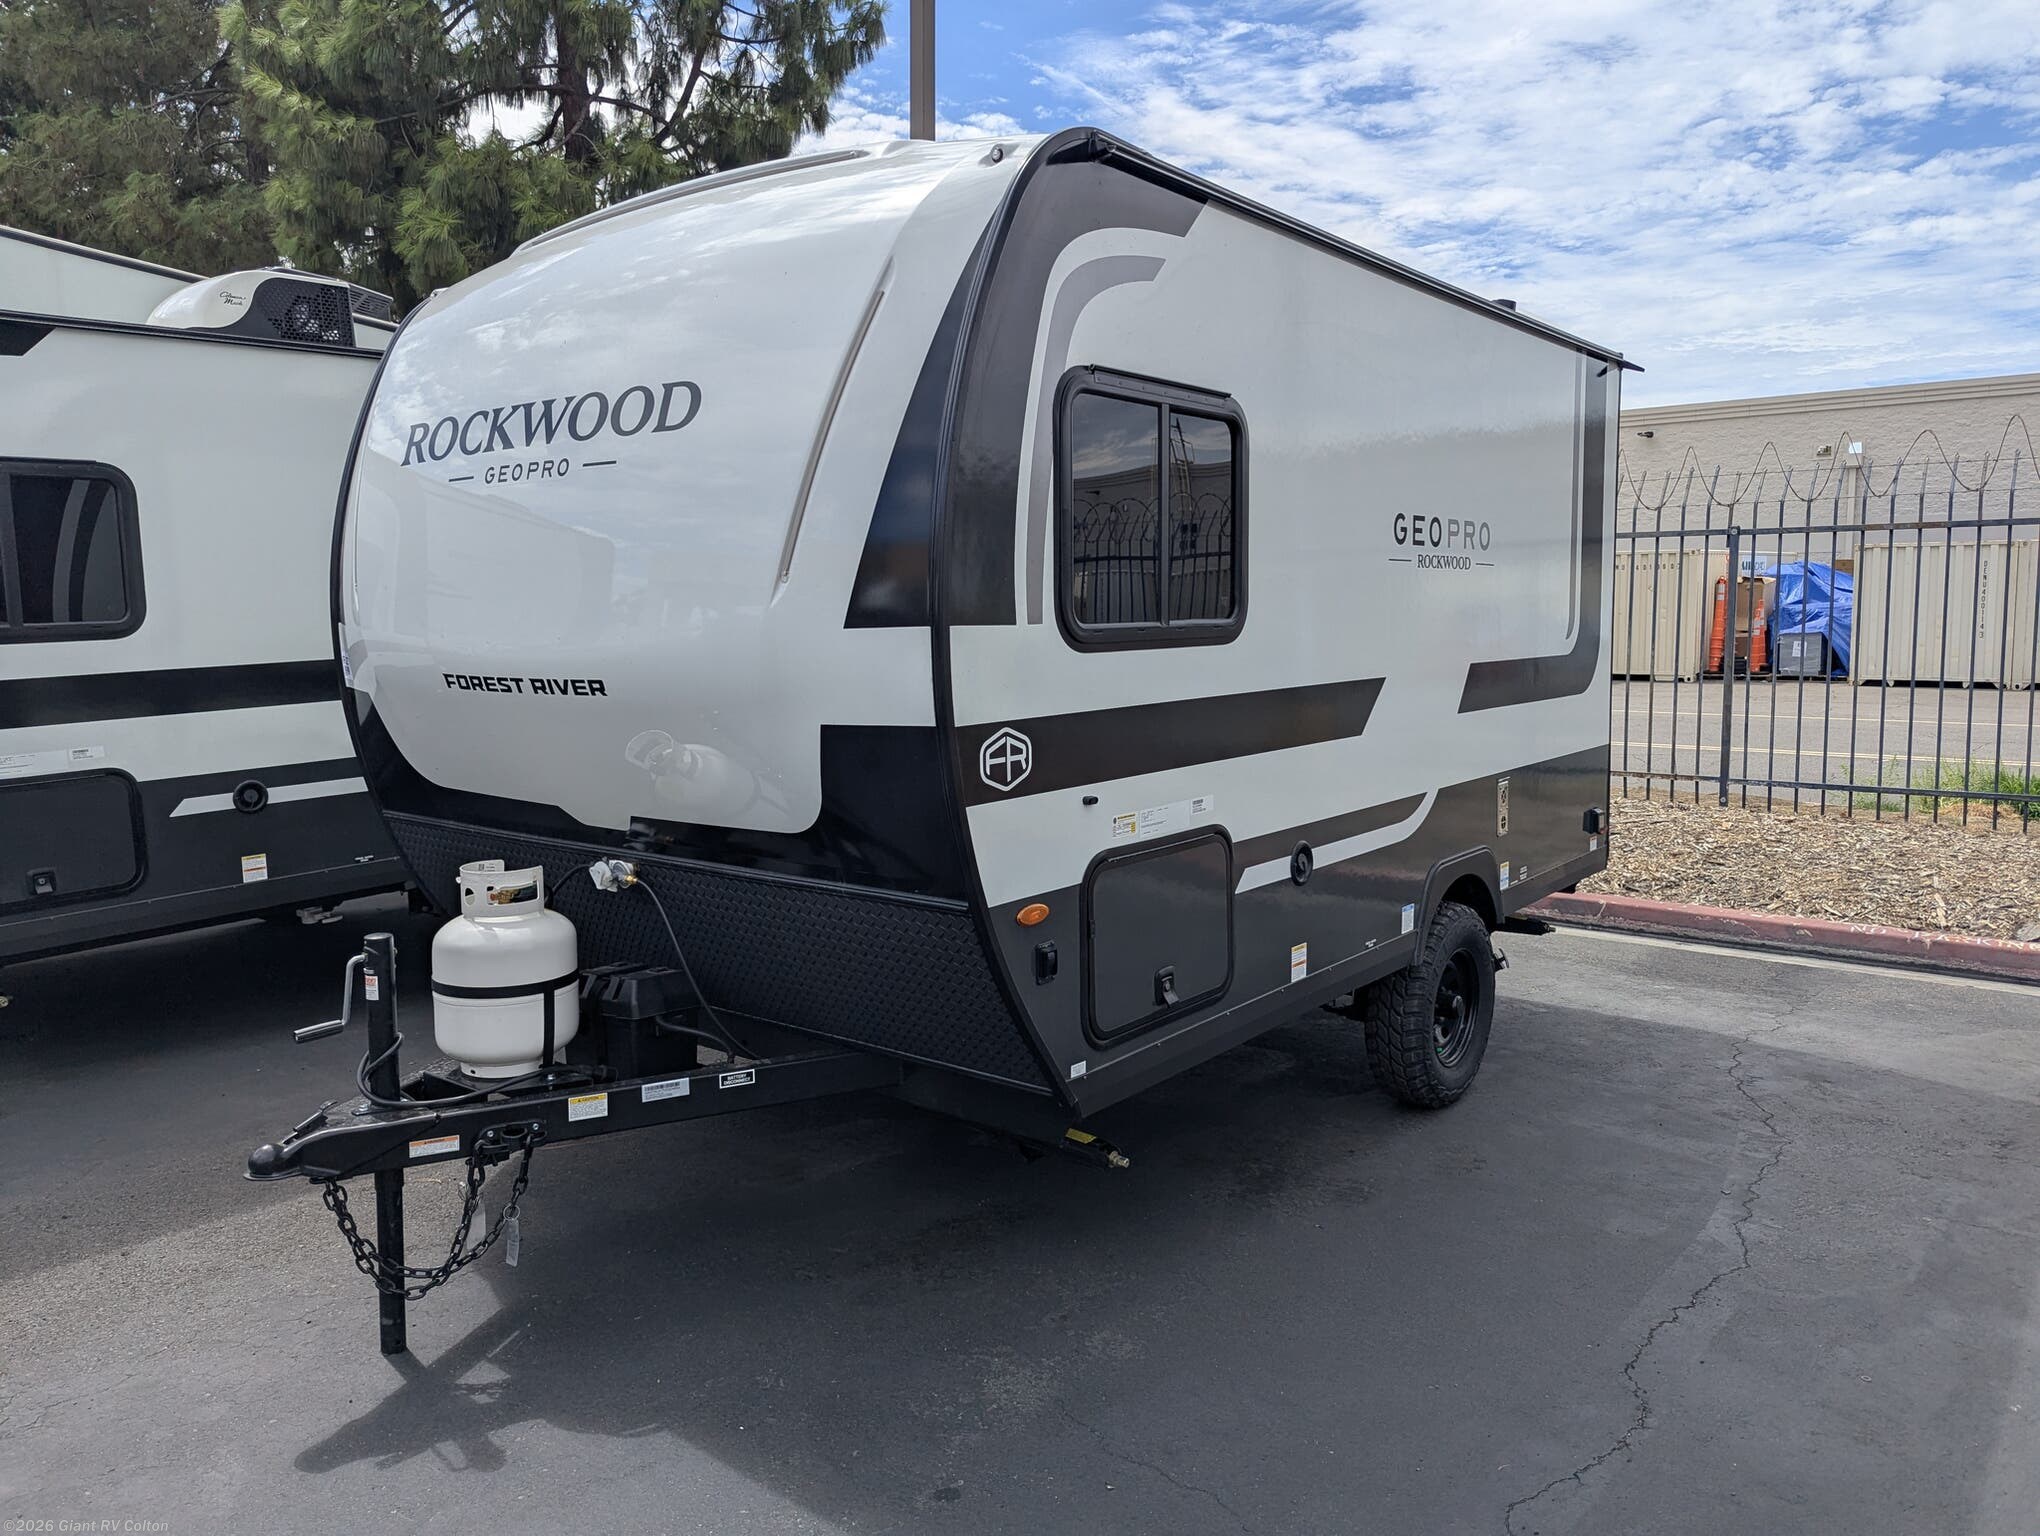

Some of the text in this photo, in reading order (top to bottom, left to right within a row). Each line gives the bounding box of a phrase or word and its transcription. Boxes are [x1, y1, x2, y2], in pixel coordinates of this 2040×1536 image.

[400, 380, 702, 467] ROCKWOOD
[484, 458, 570, 485] GEOPRO
[1393, 512, 1491, 551] GEOPRO
[1417, 554, 1471, 570] ROCKWOOD
[442, 672, 608, 697] FOREST RIVER
